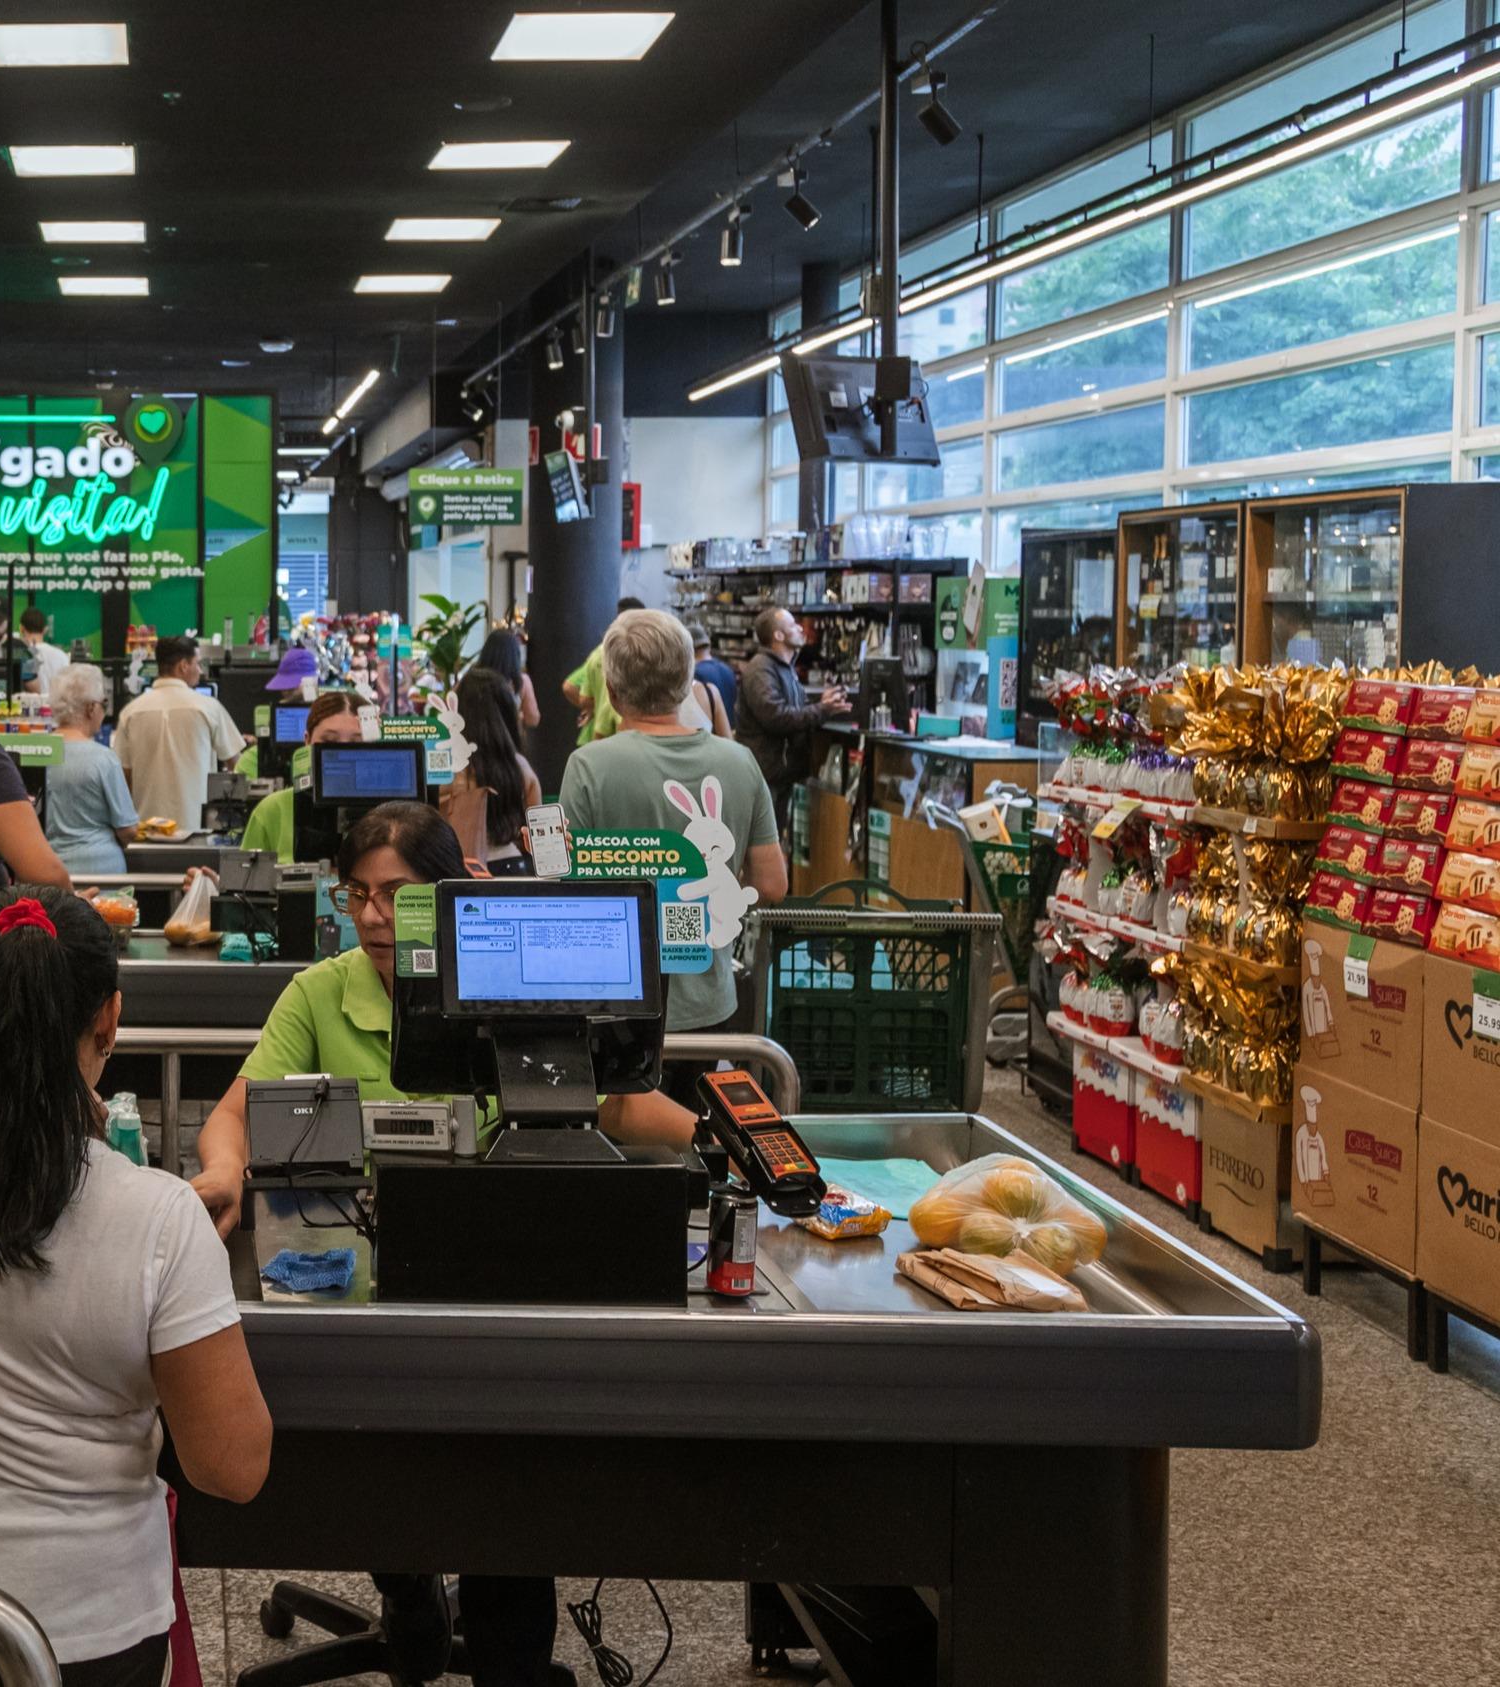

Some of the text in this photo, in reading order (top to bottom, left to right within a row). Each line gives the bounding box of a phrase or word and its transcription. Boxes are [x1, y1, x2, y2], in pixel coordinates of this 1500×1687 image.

[418, 473, 514, 486] Clique e Retire
[0, 466, 168, 546] visita!
[443, 494, 470, 503] Retire
[472, 494, 492, 505] aqui
[34, 552, 62, 564] que
[65, 549, 100, 562] você
[103, 549, 127, 562] faz
[129, 552, 149, 562] no
[152, 550, 184, 564] Pão,
[29, 563, 65, 576] mais
[68, 564, 88, 576] do
[90, 566, 119, 578] que
[121, 563, 156, 576] você
[160, 565, 205, 578] gosta.
[46, 578, 80, 592] pelo
[82, 578, 113, 592] App
[115, 580, 126, 590] e
[128, 580, 152, 590] em
[384, 726, 437, 734] DESCONTO
[4, 744, 53, 756] ABERTO
[576, 834, 661, 846] PÁSCOA COM
[577, 850, 681, 863] DESCONTO
[577, 865, 687, 876] PRA VOCÊ NO APP
[1347, 971, 1366, 985] 21,99
[1370, 1029, 1381, 1045] 12
[1209, 1146, 1265, 1190] FERRERO
[1367, 1184, 1378, 1201] 12
[1465, 1214, 1496, 1240] BELLO
